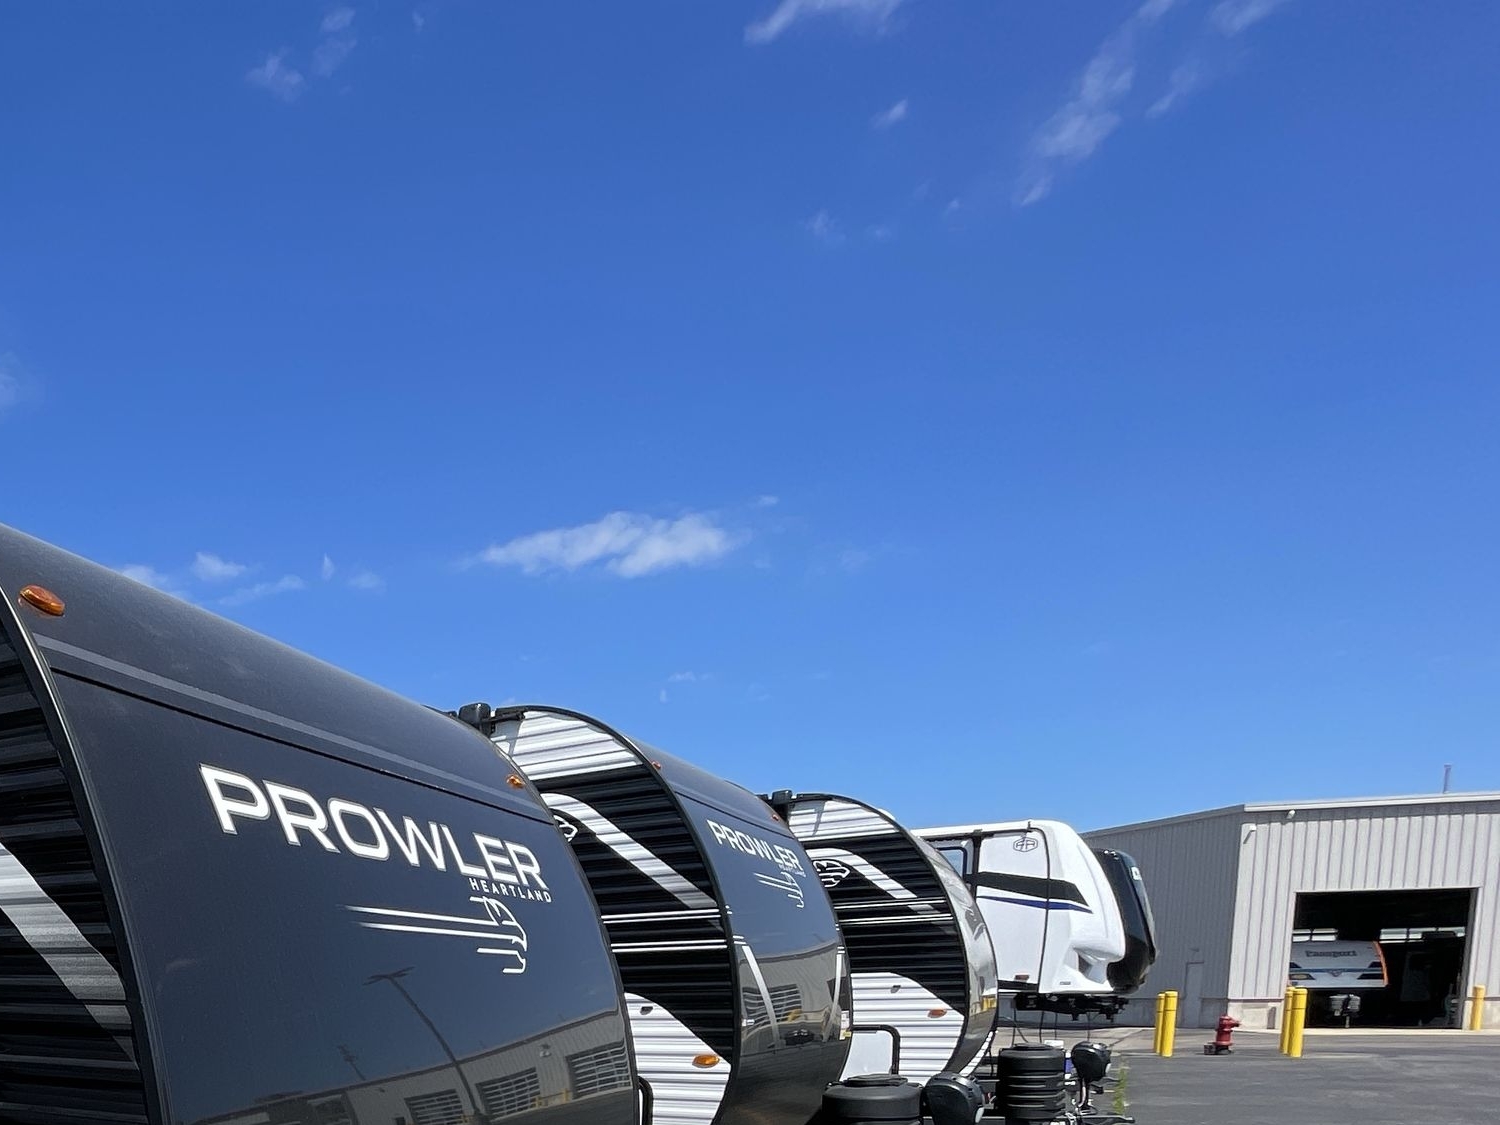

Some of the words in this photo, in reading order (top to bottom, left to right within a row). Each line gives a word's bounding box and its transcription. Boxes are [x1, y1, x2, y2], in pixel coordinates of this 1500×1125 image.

[199, 763, 550, 890] PROWLER
[706, 819, 804, 871] PROWLER
[469, 877, 552, 903] HEARTLAND
